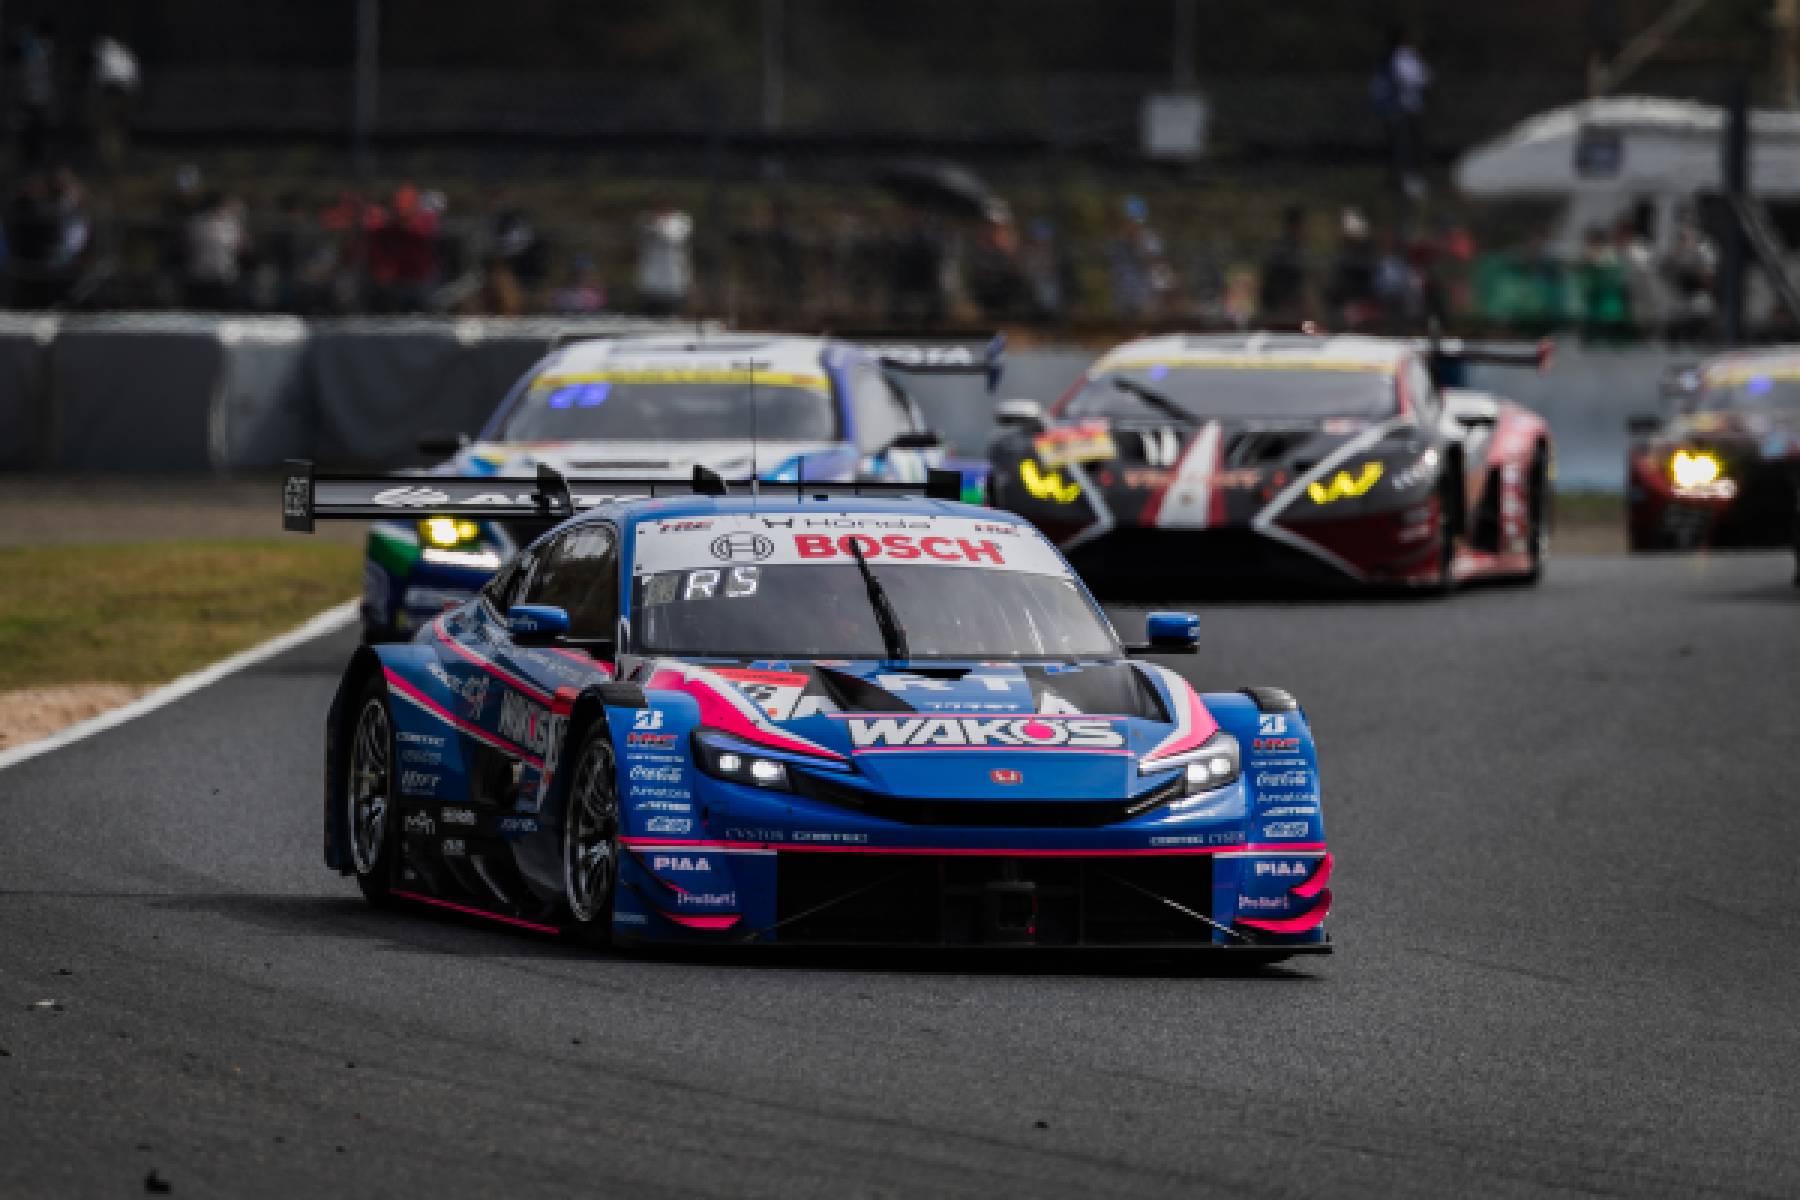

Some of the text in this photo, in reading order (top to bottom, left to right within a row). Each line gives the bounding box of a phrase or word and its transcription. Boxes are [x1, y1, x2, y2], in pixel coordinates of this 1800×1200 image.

[794, 534, 1006, 565] BOSCH
[653, 857, 712, 871] PIAA
[1255, 862, 1307, 877] PIAA
